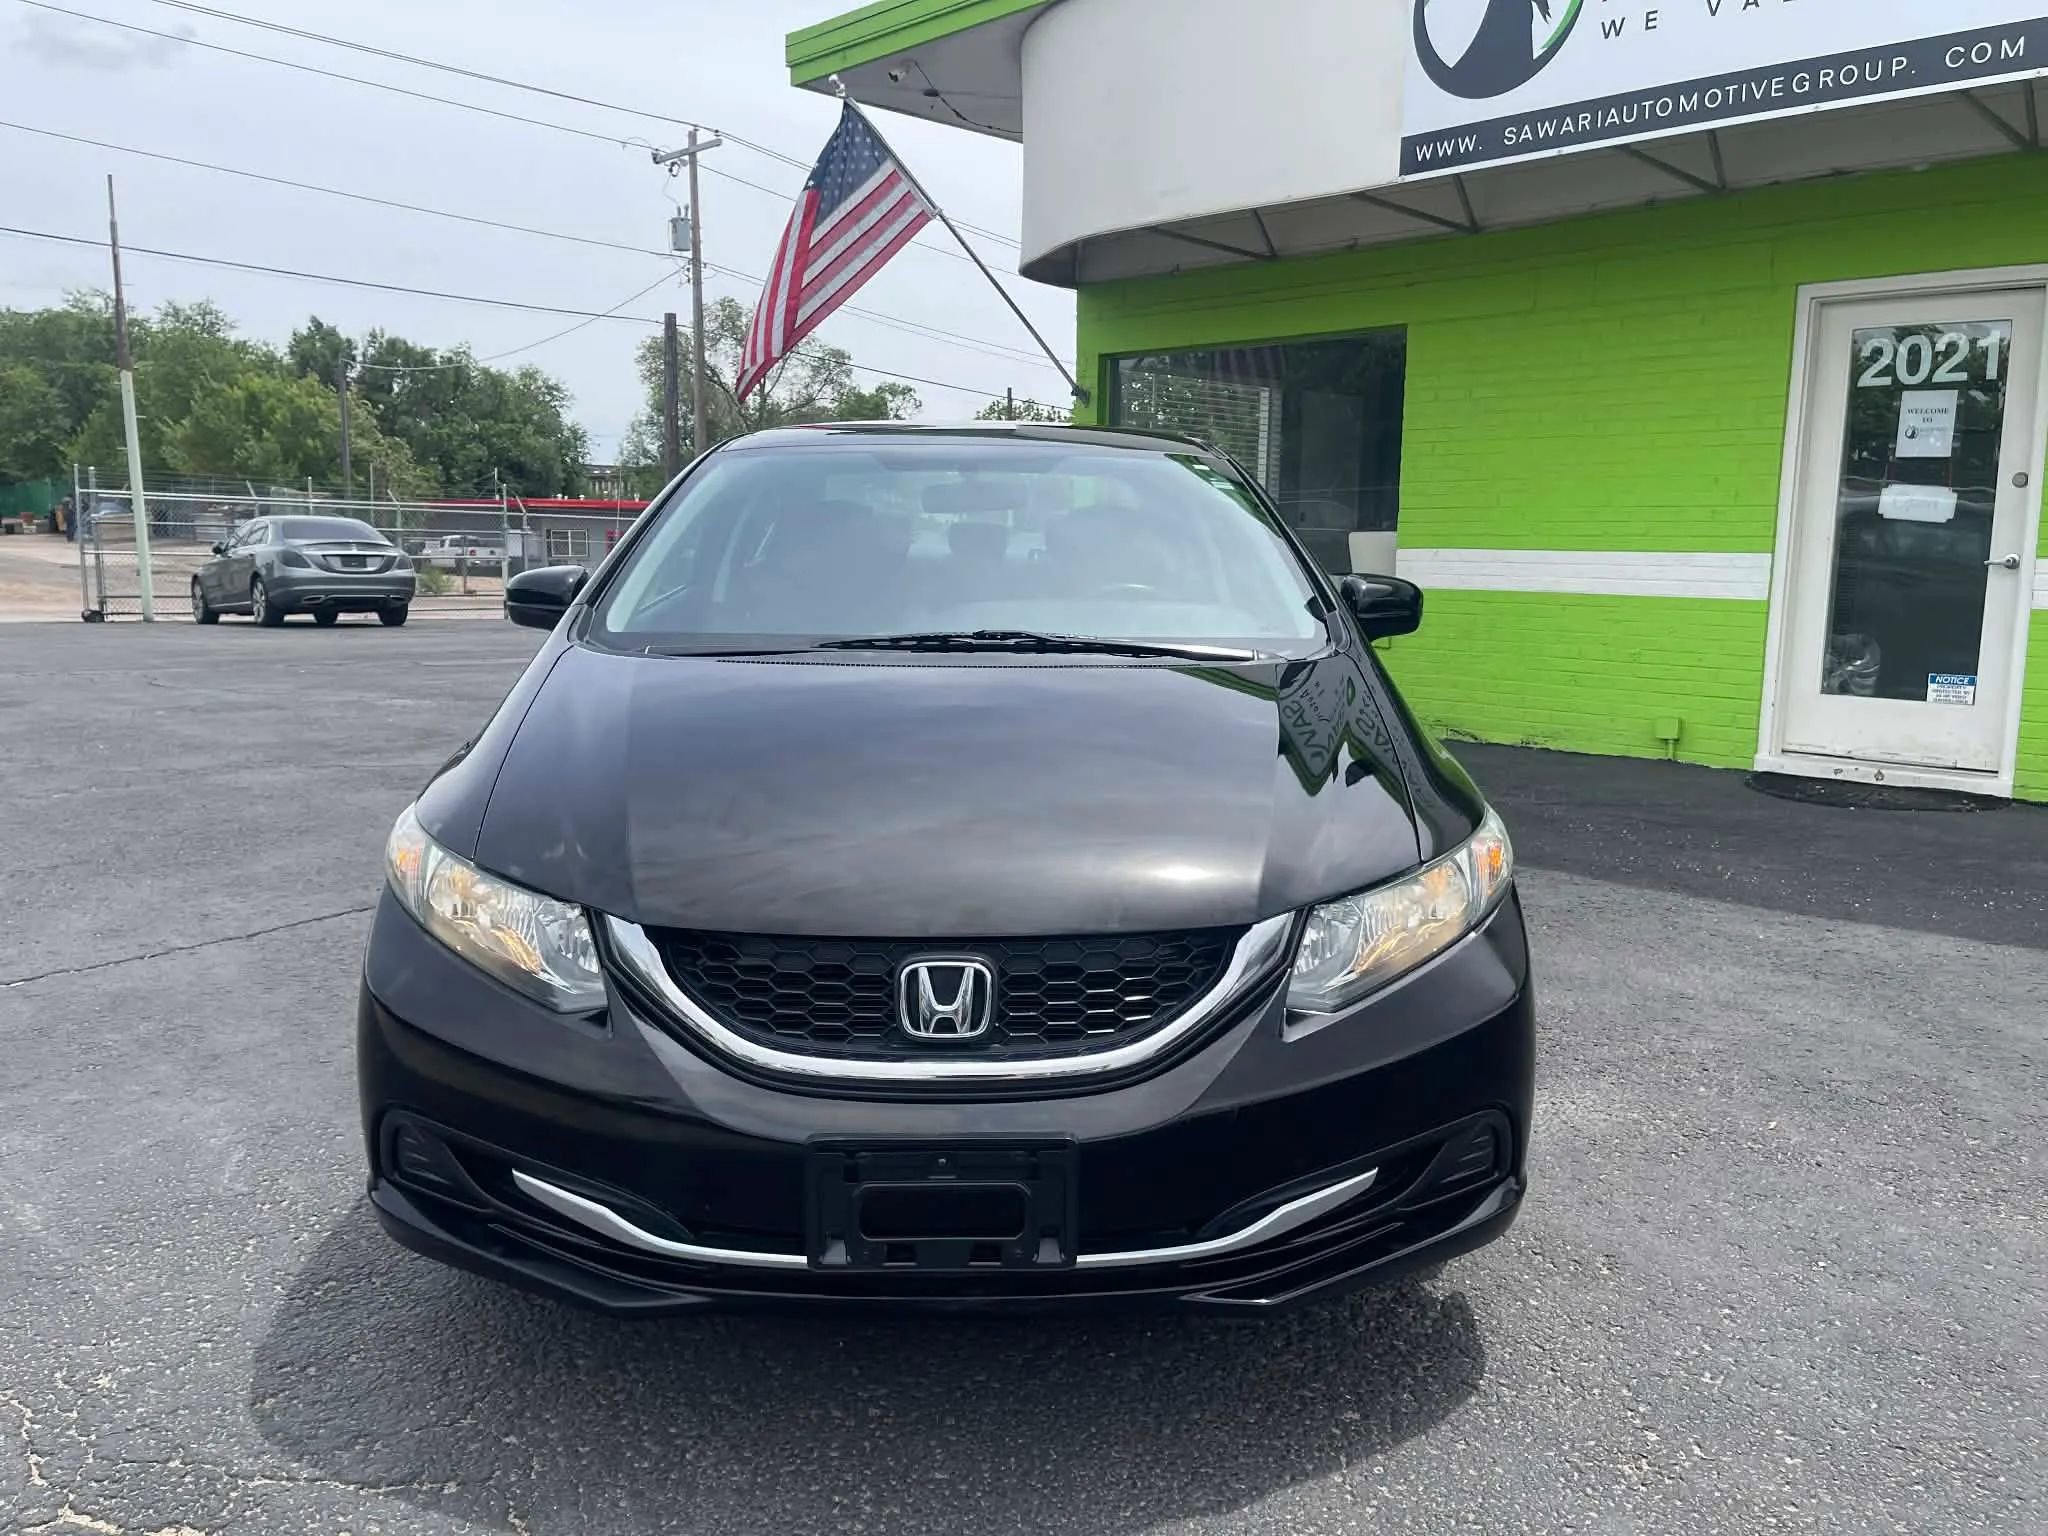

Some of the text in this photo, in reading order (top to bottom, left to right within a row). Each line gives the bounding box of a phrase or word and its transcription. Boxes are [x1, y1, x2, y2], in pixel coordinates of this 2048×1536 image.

[1601, 10, 1658, 39] WE
[1416, 134, 1482, 161] WWW.
[1945, 35, 2025, 68] COM
[1857, 330, 2001, 387] 2021
[1935, 675, 1969, 685] NOTICE
